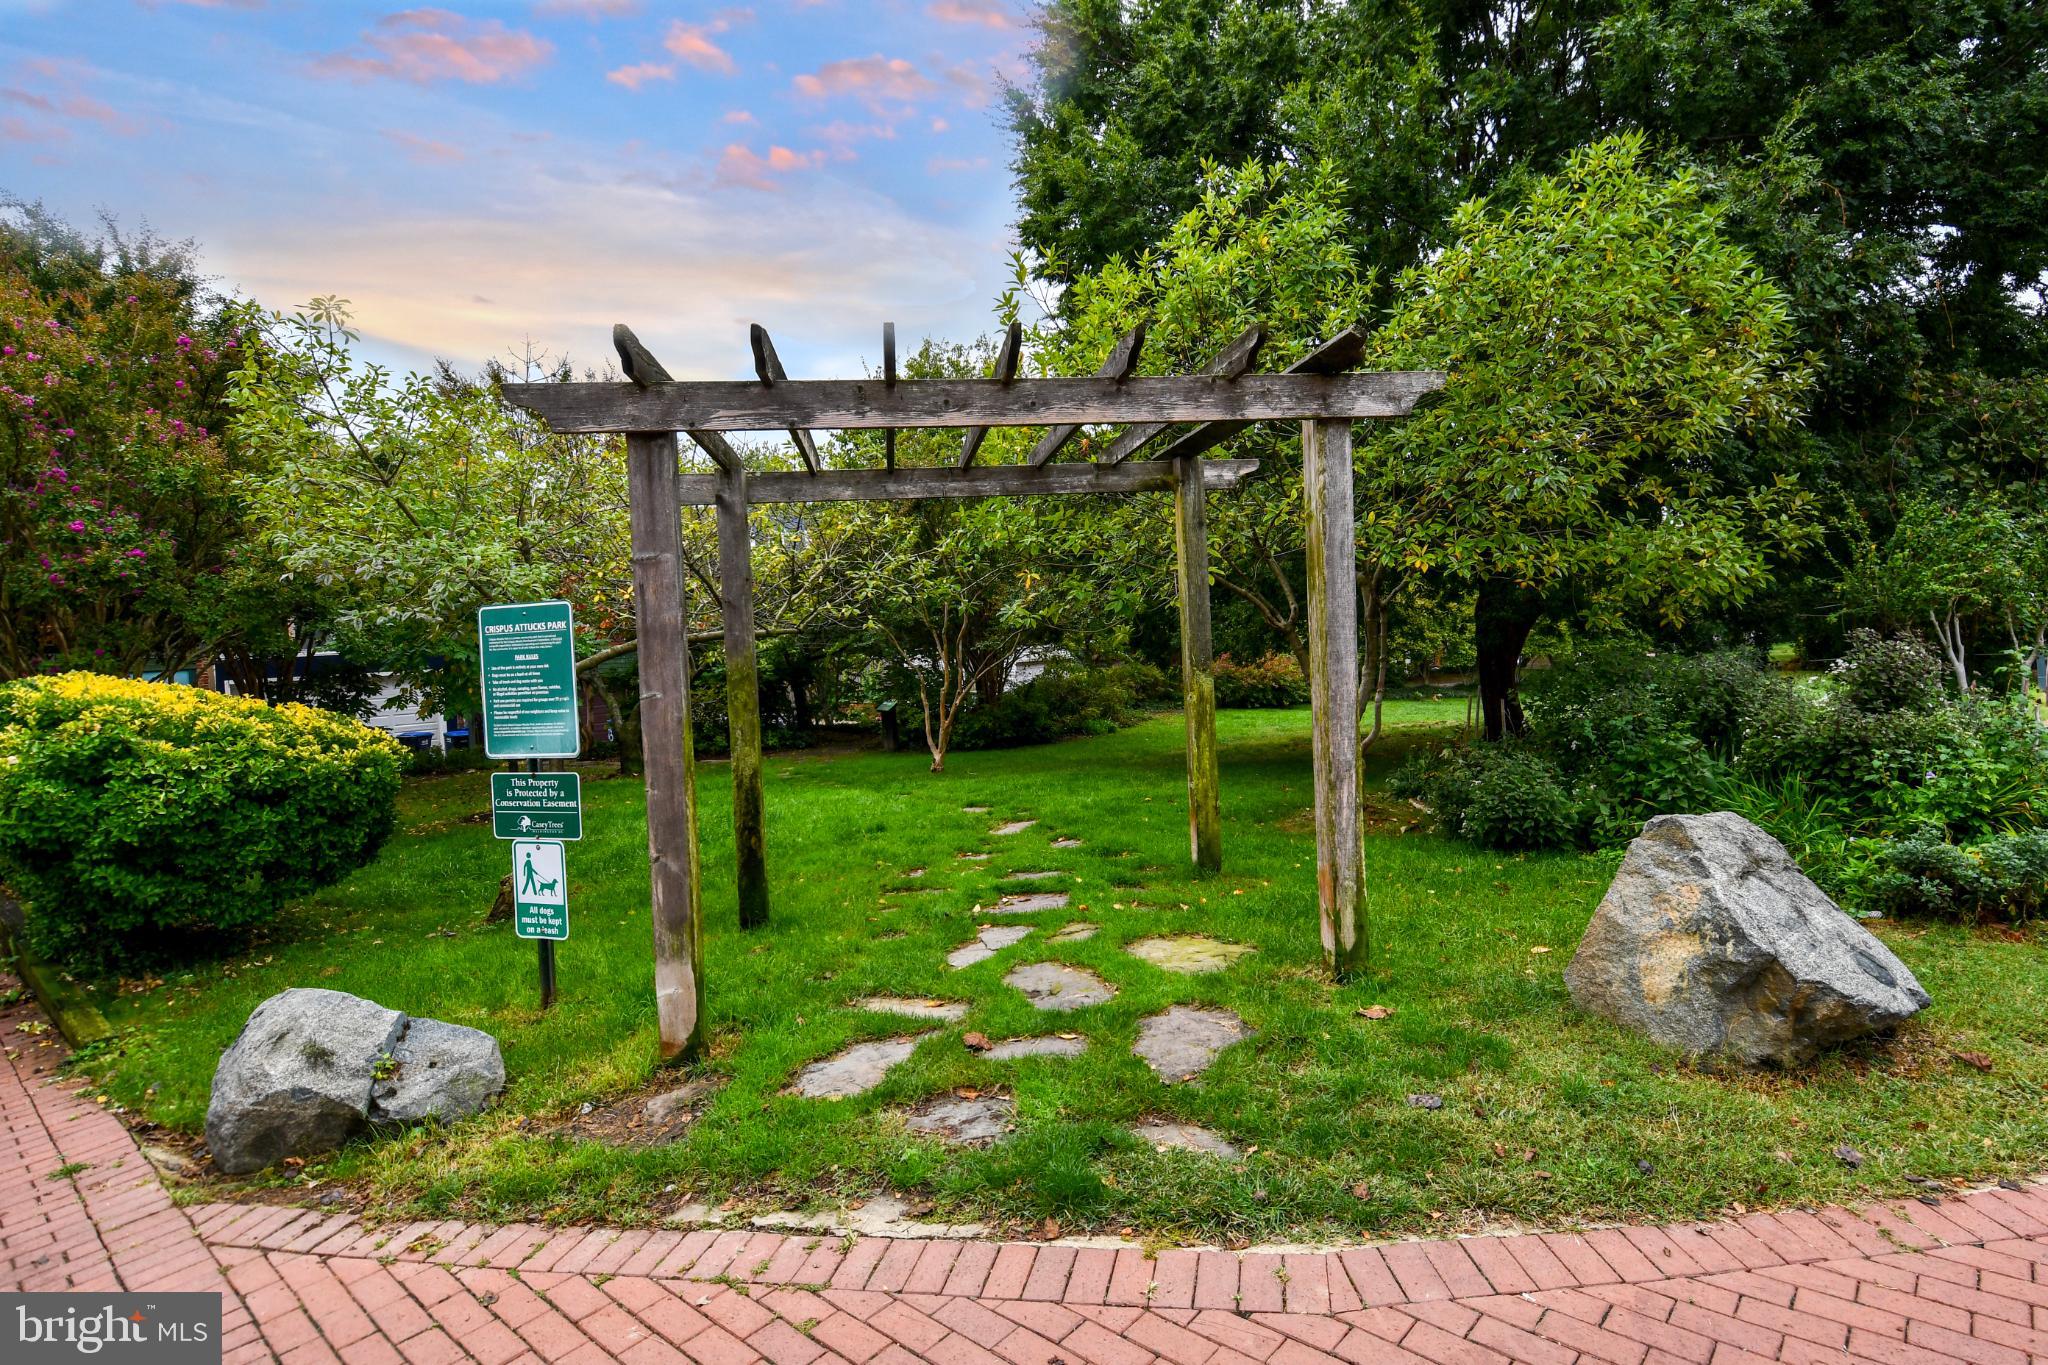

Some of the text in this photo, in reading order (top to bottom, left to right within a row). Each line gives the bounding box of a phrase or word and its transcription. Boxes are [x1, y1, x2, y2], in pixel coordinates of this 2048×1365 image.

[484, 620, 567, 634] CRISPUS ATTUCKS PARK
[510, 778, 559, 789] This Property
[506, 788, 513, 797] is
[514, 788, 547, 797] Protected
[549, 788, 558, 799] by
[495, 798, 577, 808] Conservation Easement
[529, 906, 554, 917] All dogs
[521, 916, 563, 927] must be kept
